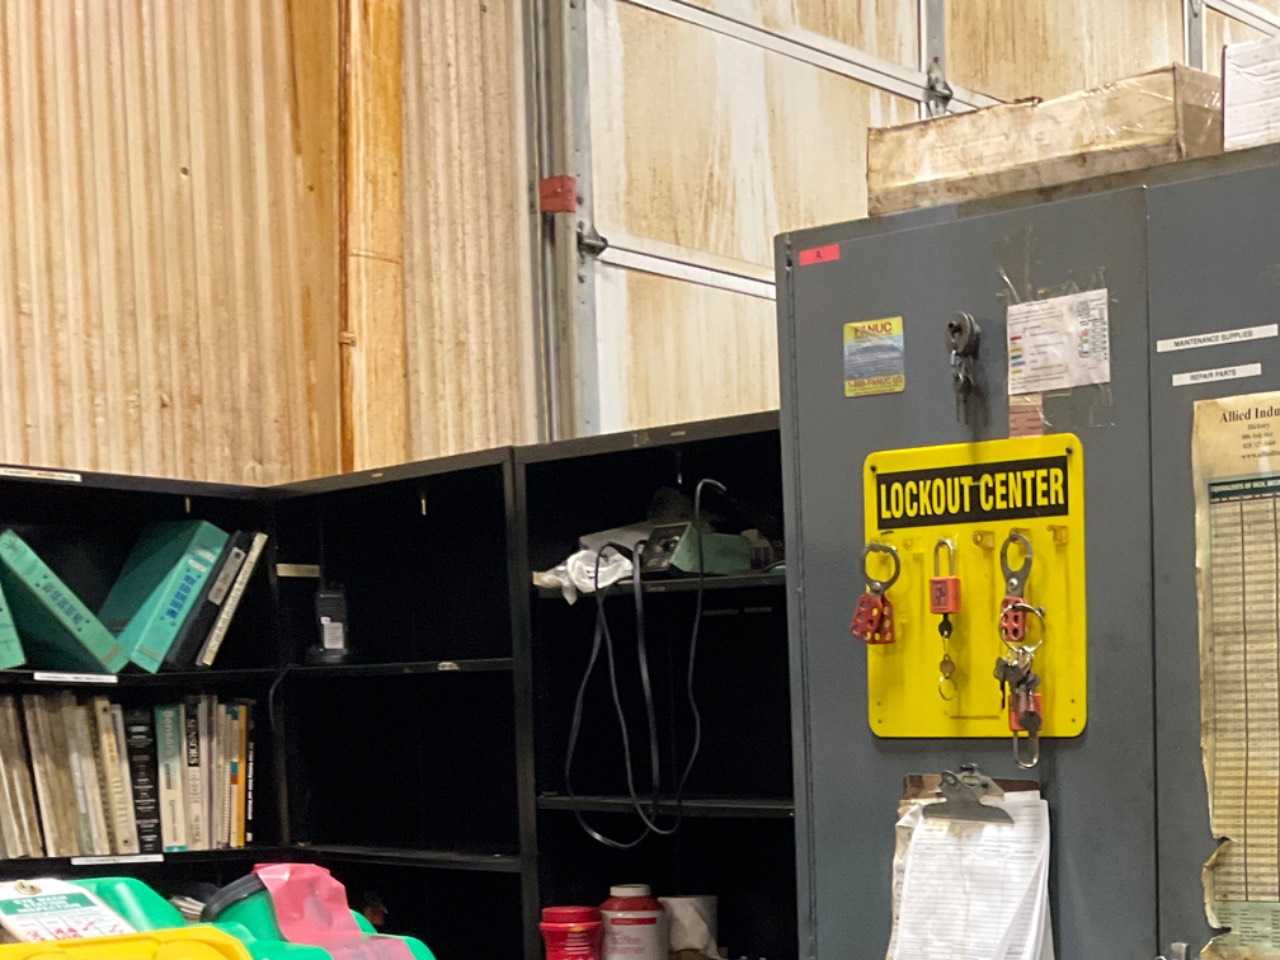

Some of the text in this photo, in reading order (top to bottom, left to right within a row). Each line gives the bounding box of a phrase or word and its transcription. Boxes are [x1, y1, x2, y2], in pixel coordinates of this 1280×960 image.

[1174, 330, 1253, 347] MAINTENANCE SUPPLIES
[1190, 369, 1237, 381] REPAIR PARTS
[1219, 408, 1251, 424] Allied
[880, 467, 1065, 519] LOCKOUT CENTER
